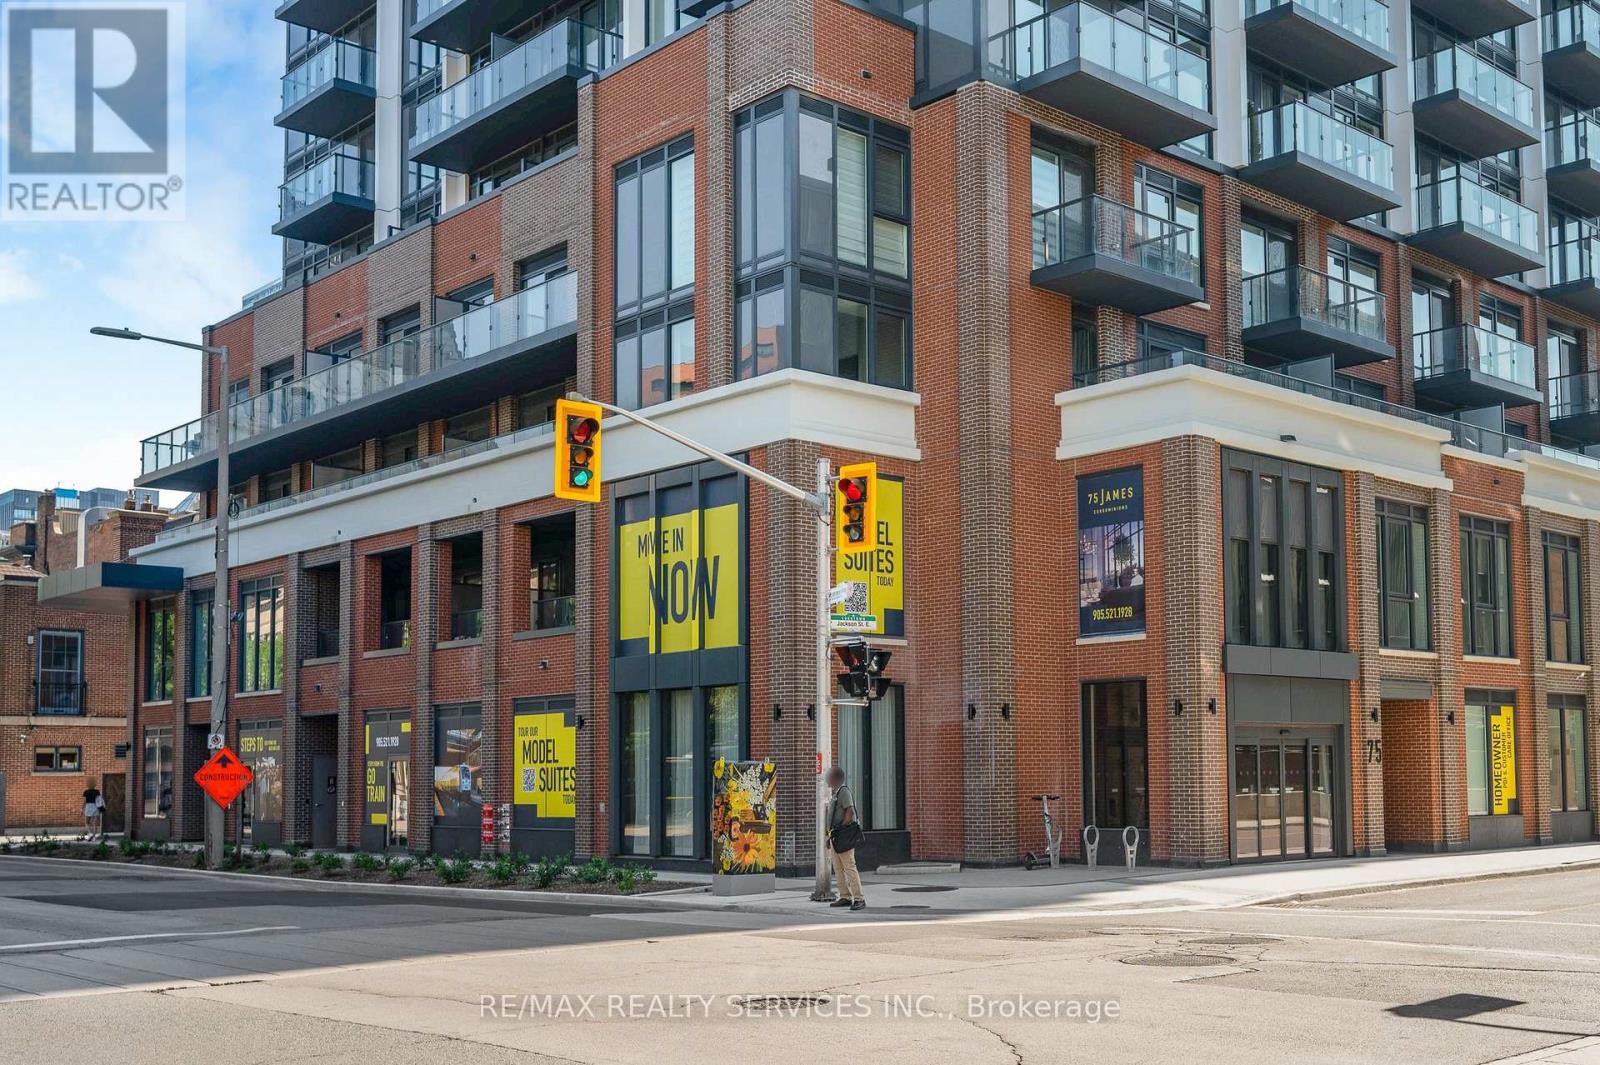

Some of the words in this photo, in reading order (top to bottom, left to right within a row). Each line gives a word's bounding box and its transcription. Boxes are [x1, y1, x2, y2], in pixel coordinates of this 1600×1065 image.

[1088, 492, 1099, 505] 75
[1100, 486, 1133, 506] JAMES
[638, 530, 669, 558] MVE
[672, 527, 684, 553] IN
[649, 555, 720, 625] NOW
[877, 575, 894, 587] TODAY
[1092, 606, 1133, 621] 905.521.1928
[240, 737, 256, 752] STEPS
[257, 736, 264, 751] TO
[523, 739, 559, 765] MODEL
[1367, 740, 1381, 763] 75
[1492, 723, 1503, 806] HOMEOWNER
[200, 773, 248, 781] CONSTRUCTION
[367, 767, 376, 785] GO
[539, 766, 576, 792] SUITES
[366, 785, 385, 803] TRAIN
